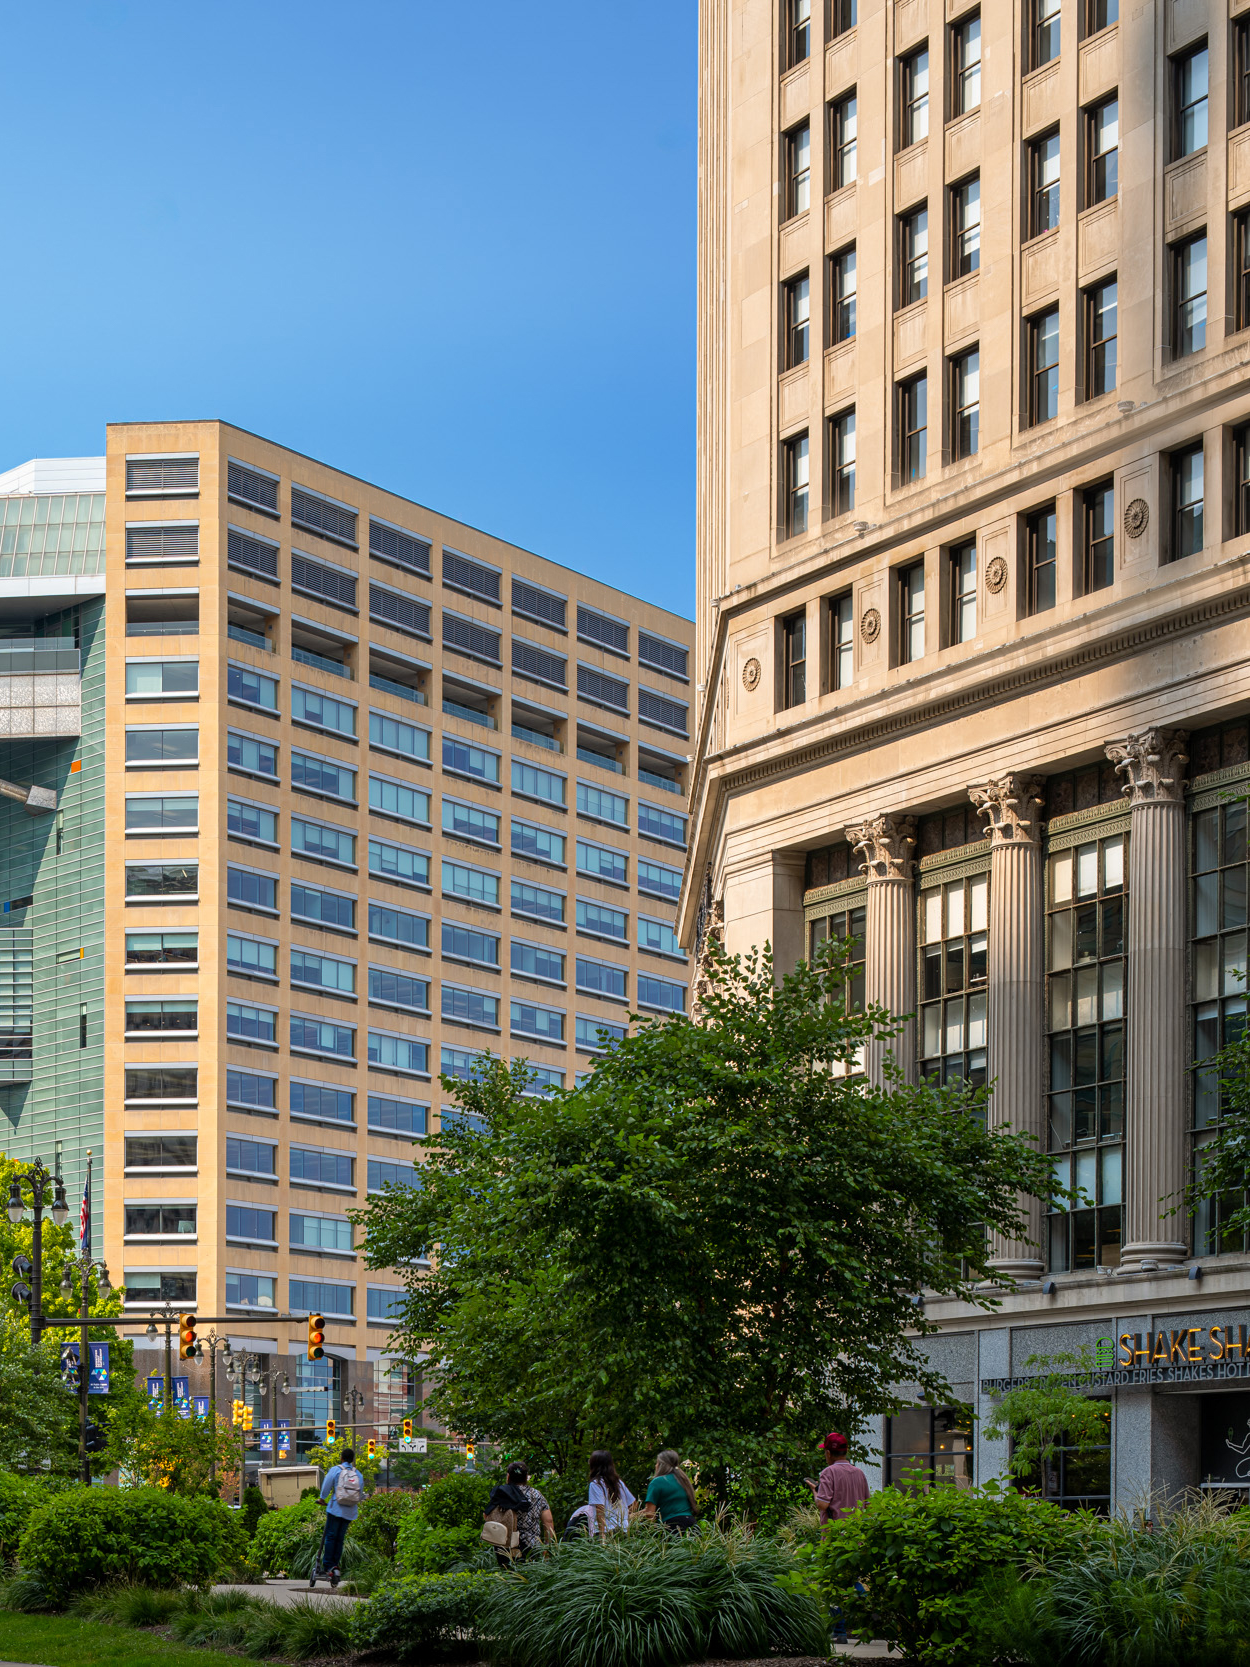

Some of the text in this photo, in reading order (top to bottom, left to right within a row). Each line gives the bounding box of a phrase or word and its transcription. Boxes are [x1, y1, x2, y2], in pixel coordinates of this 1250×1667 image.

[1118, 1328, 1205, 1366] SHAKE
[1133, 1368, 1163, 1384] FRIES
[1167, 1364, 1213, 1381] SHAKES
[1217, 1362, 1245, 1378] HOT
